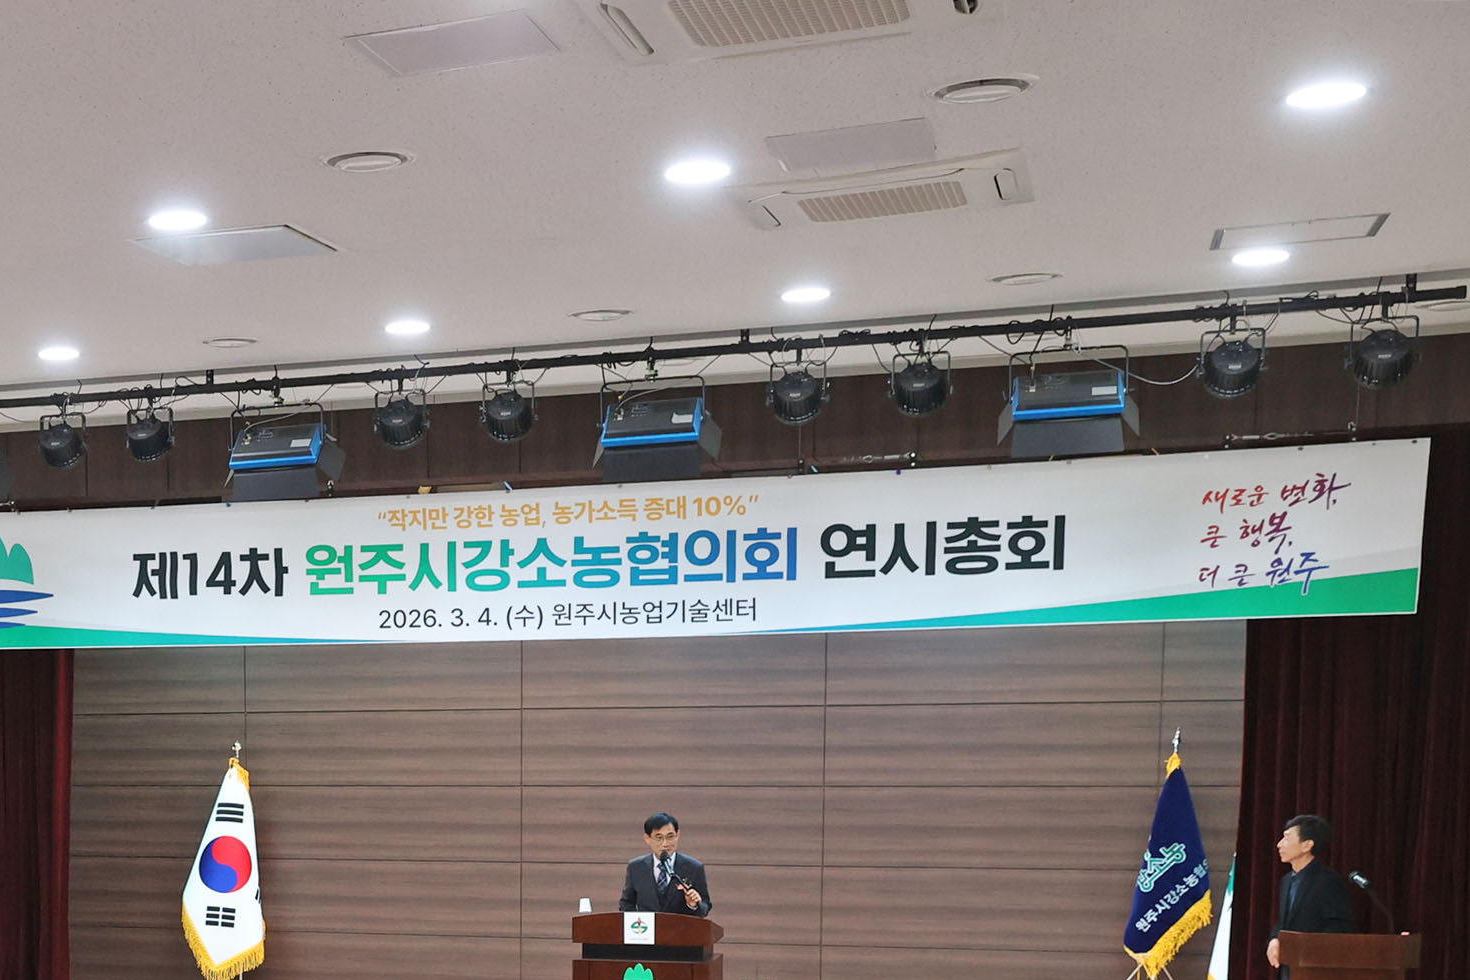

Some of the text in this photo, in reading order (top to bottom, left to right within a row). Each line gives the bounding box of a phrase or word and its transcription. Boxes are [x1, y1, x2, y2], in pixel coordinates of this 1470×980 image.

[453, 504, 495, 529] 강한
[499, 502, 547, 529] 농업,
[552, 498, 639, 525] 농가소득
[642, 496, 688, 520] 증대
[1201, 472, 1352, 514] 새로운 변화,
[1200, 511, 1294, 556] 큰 행복,
[131, 514, 1066, 600] 제14차 원주시강소농협의회 연시총회
[1198, 551, 1331, 596] 더 큰 원주
[378, 596, 758, 631] 2026. 3. 4. (수) 원주시농업기술센터
